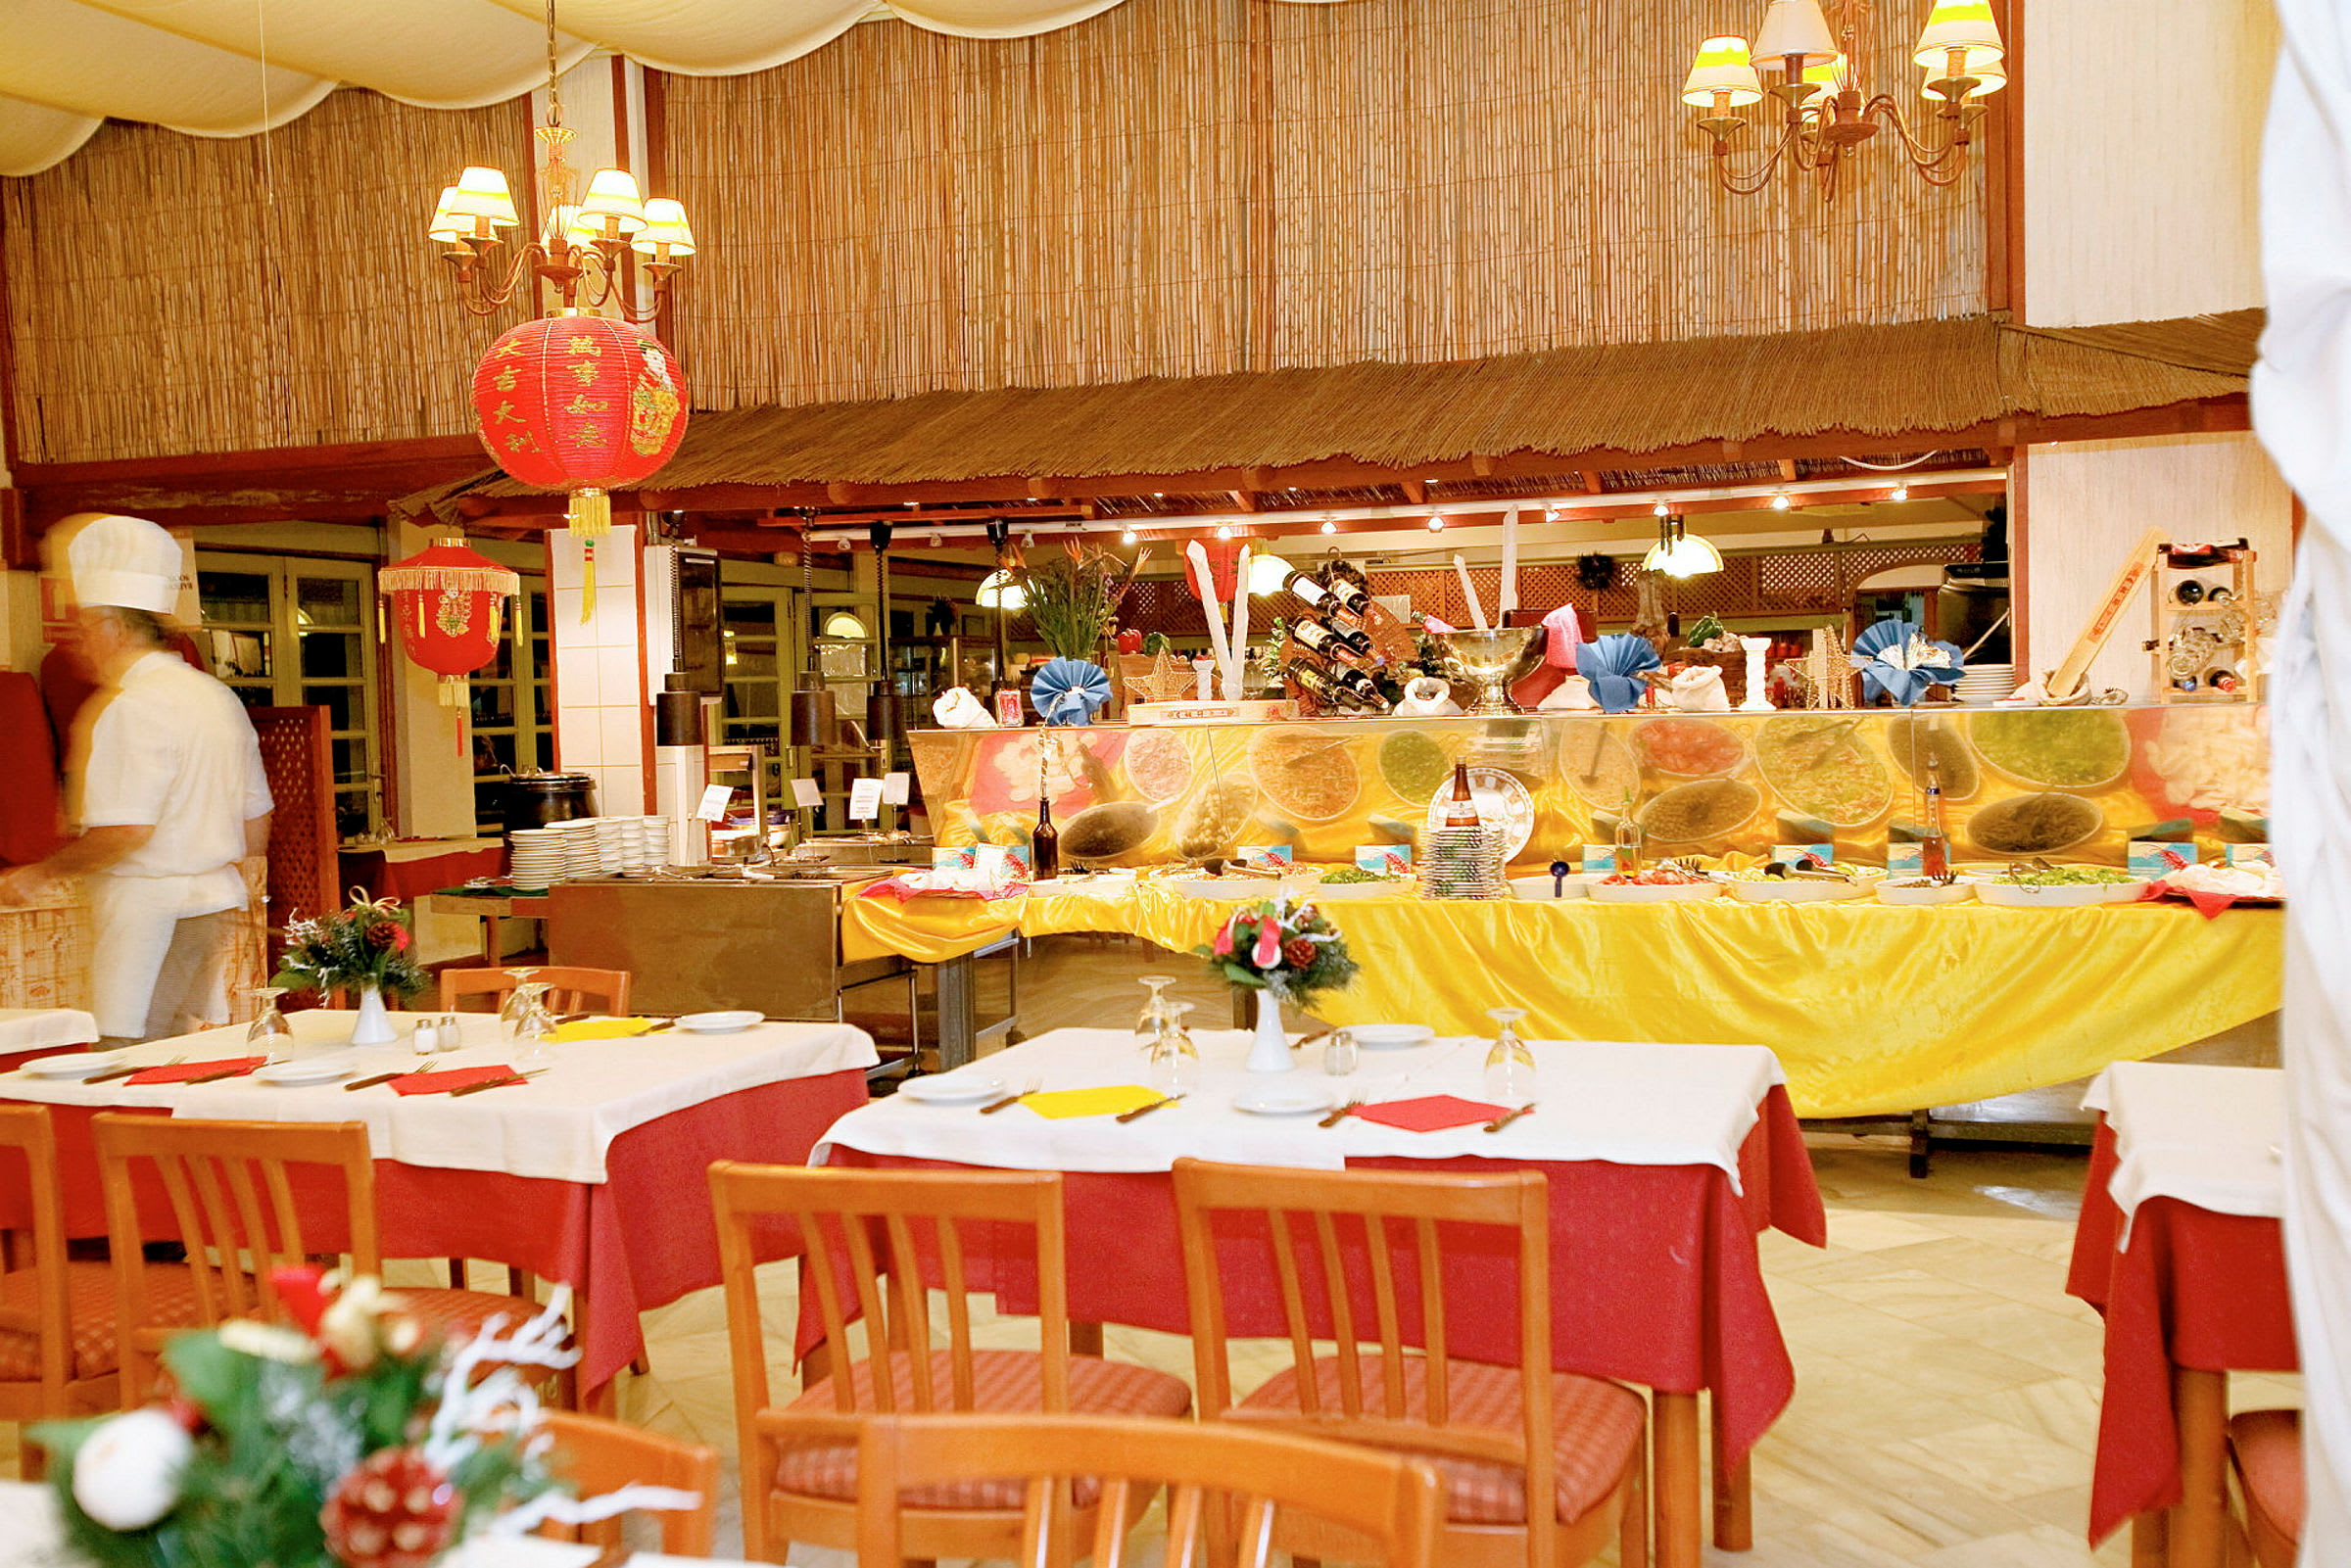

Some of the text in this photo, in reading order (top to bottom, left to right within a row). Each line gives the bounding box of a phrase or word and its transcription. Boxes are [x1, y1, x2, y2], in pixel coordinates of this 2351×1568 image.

[493, 339, 540, 452] 大吉大利
[563, 335, 608, 448] 萬事如意
